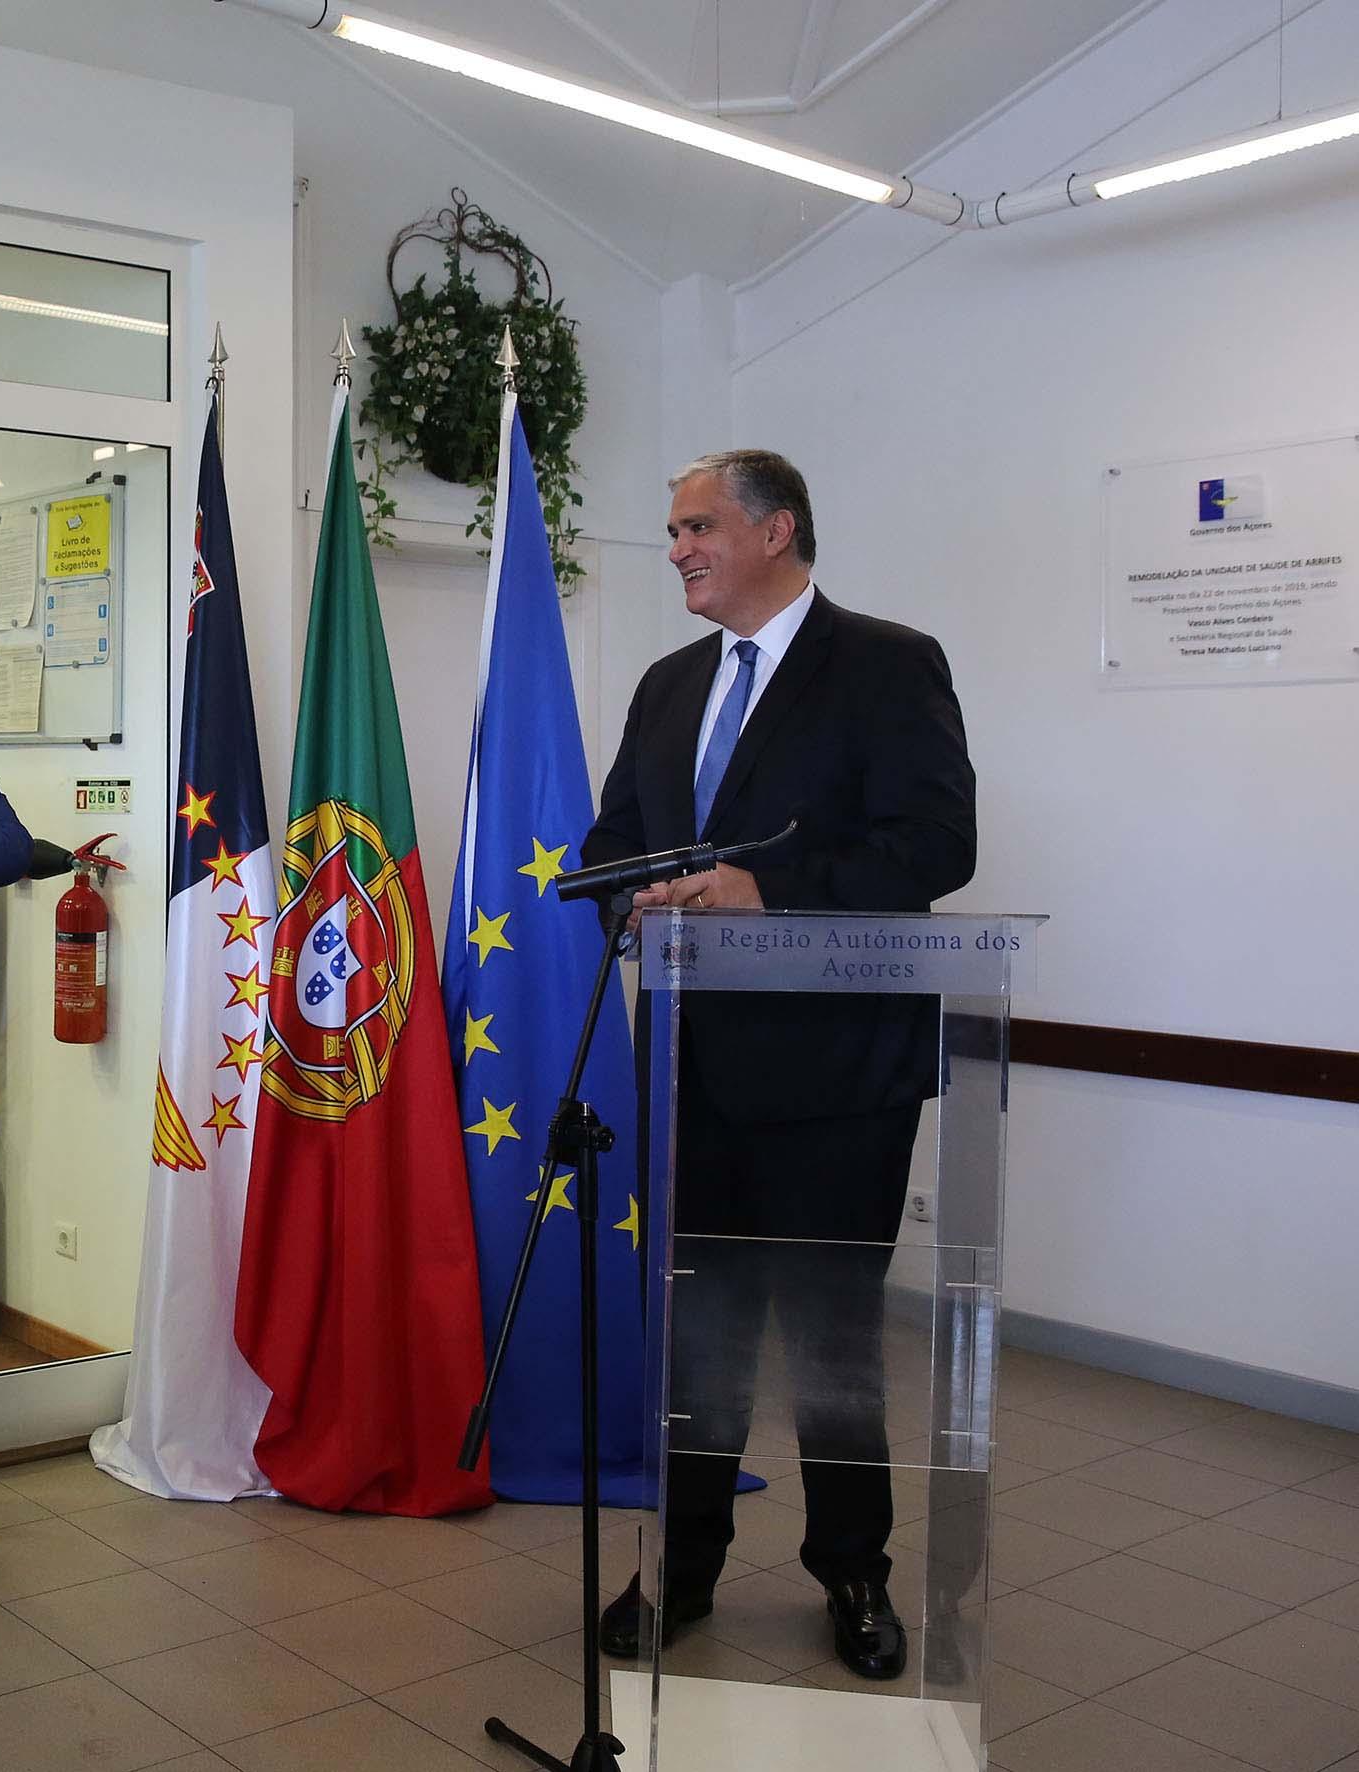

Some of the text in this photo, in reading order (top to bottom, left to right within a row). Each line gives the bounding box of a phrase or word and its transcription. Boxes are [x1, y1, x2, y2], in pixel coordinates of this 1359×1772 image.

[1189, 521, 1272, 537] Governo dos Açores
[61, 535, 91, 547] Livro de
[53, 547, 101, 560] Reclamações
[60, 560, 99, 572] Sugestões
[1128, 569, 1189, 582] REMODELAÇÃO
[1191, 568, 1203, 577] DA
[1205, 565, 1243, 576] UNIDADE
[1246, 564, 1256, 572] DE
[1292, 559, 1302, 568] DE
[1305, 555, 1342, 567] ARRIFES
[1213, 588, 1225, 597] de
[1271, 582, 1283, 592] de
[1163, 605, 1204, 616] Presidente
[1219, 602, 1254, 612] Governo
[1255, 599, 1271, 609] dos
[1272, 598, 1302, 609] Açores
[1188, 614, 1274, 628] Vasco Alves Cordeiro
[1218, 629, 1253, 643] Regional
[1181, 643, 1282, 656] Teresa Machado Luciano
[719, 928, 1021, 953] Região Autónoma dos
[822, 957, 915, 982] Açores
